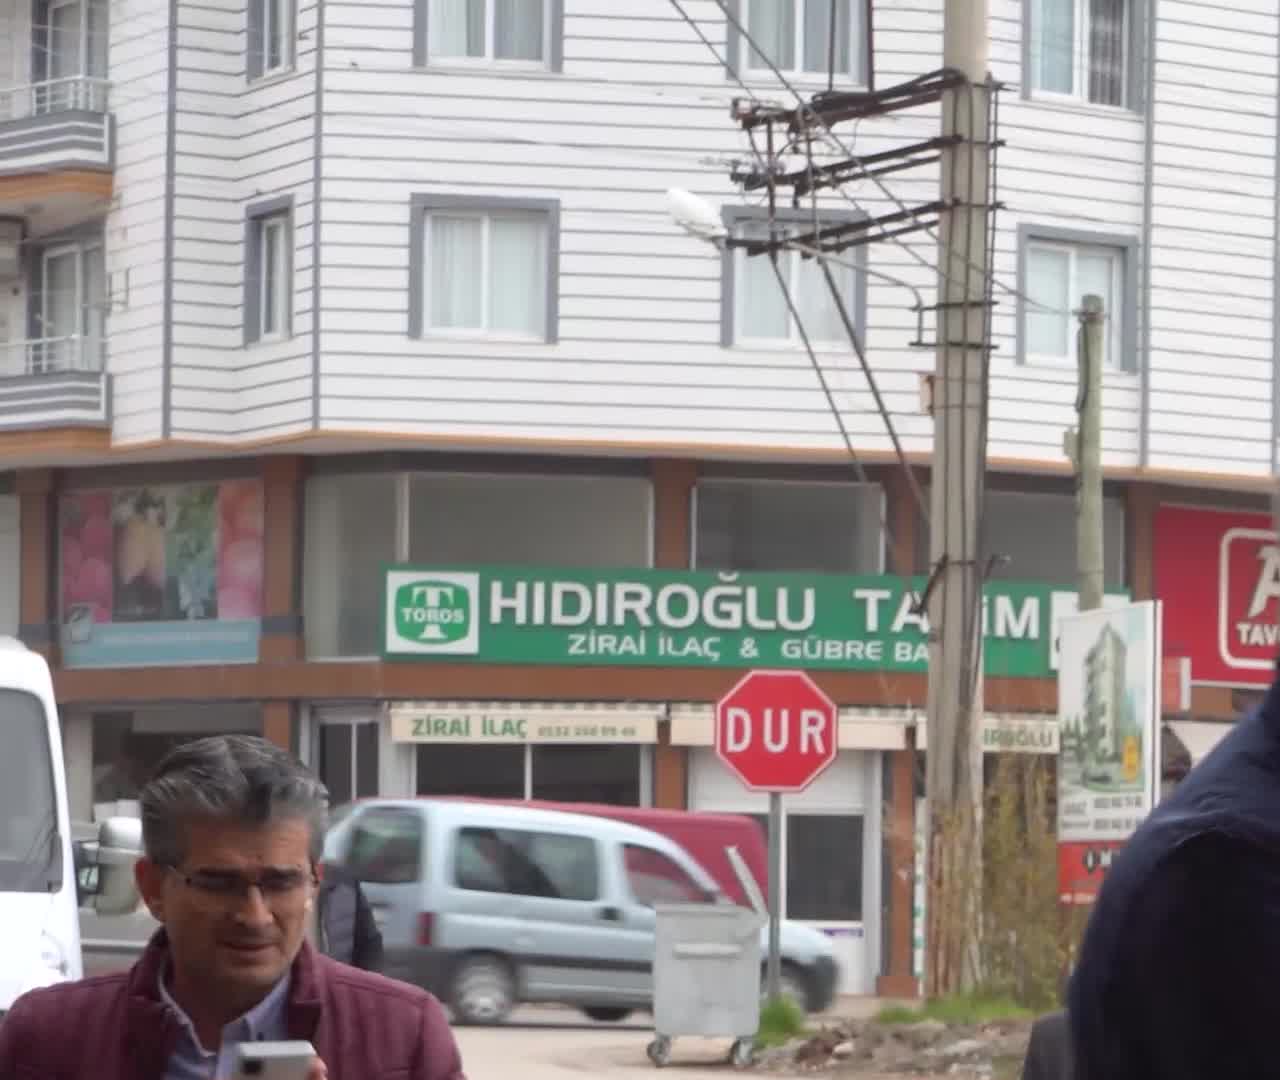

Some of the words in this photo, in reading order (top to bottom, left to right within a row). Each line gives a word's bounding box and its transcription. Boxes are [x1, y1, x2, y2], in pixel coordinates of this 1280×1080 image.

[402, 607, 465, 623] TOROS
[489, 571, 816, 632] HIDIROĞLU
[853, 588, 1040, 639] TAİM
[568, 630, 646, 656] ZİRAİ
[659, 632, 721, 661] İLAÇ
[740, 638, 758, 658] &
[781, 634, 883, 661] GÜBRE
[895, 641, 931, 662] BA
[411, 715, 470, 737] ZİRAİ
[481, 714, 528, 739] İLAÇ
[726, 708, 826, 753] DUR
